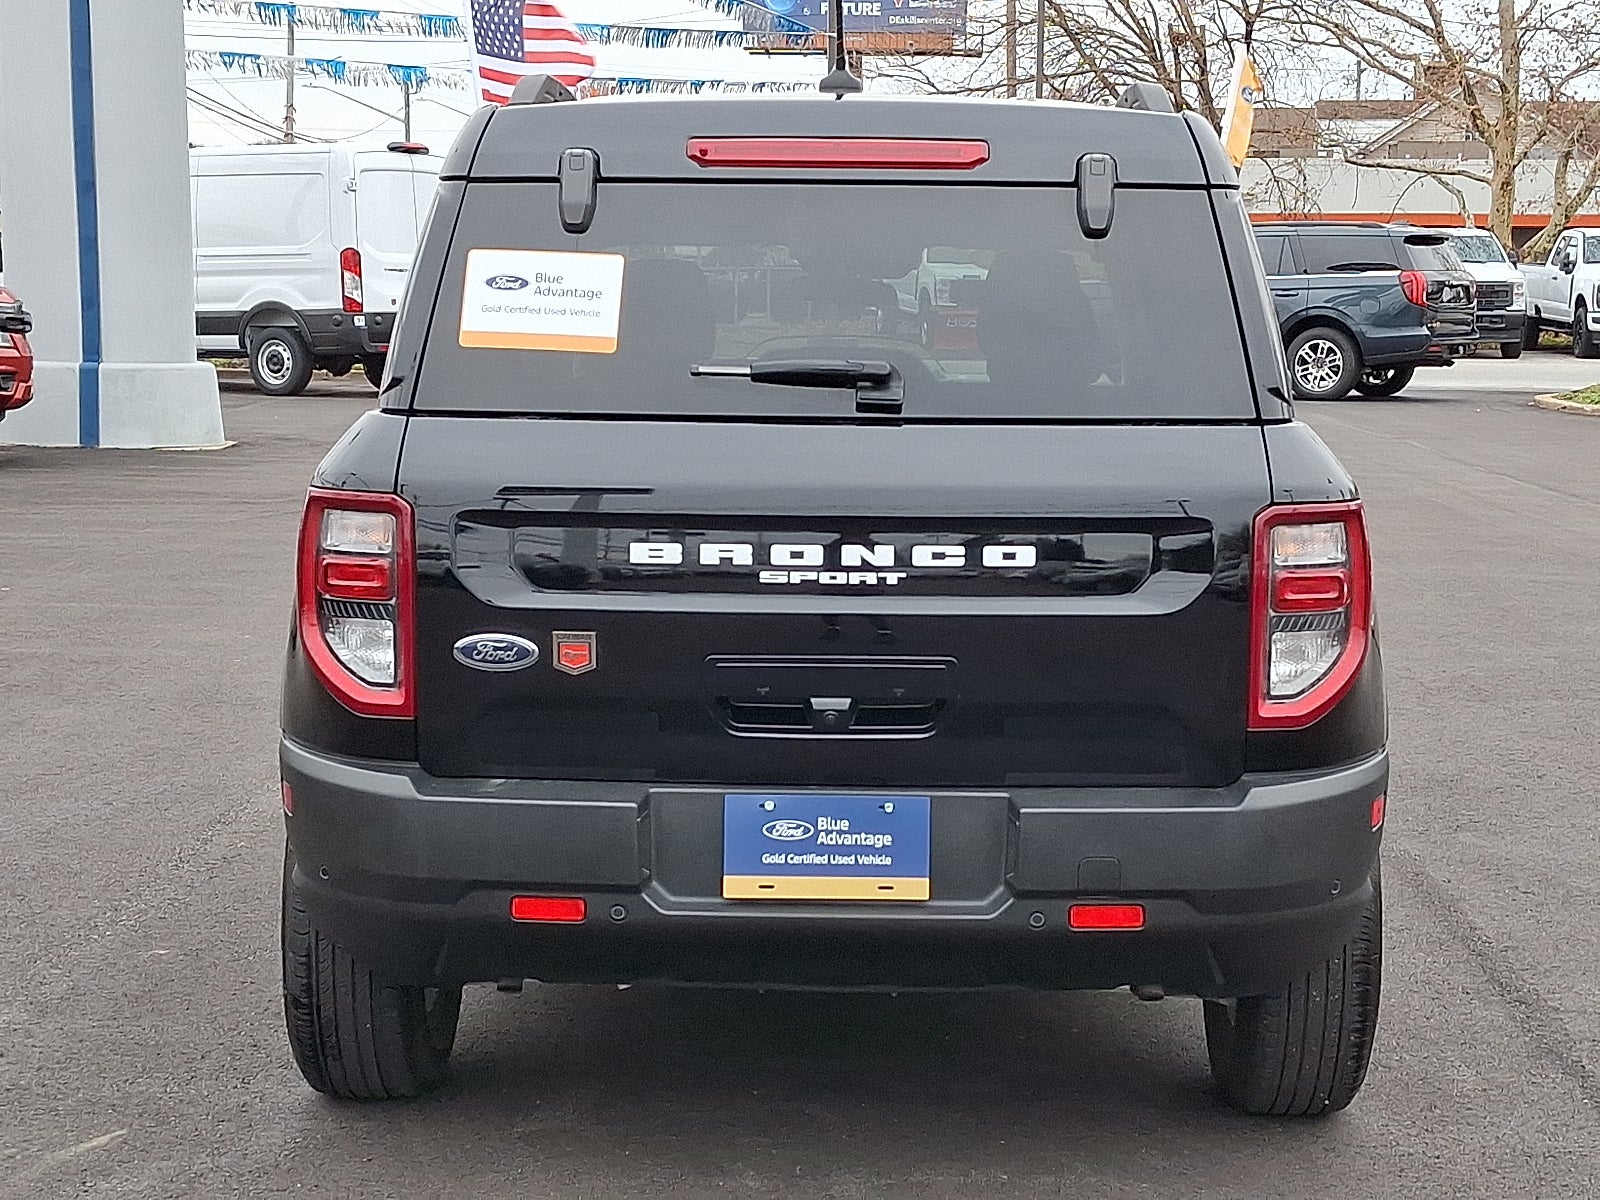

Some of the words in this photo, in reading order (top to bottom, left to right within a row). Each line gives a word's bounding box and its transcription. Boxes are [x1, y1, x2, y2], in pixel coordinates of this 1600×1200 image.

[820, 2, 882, 16] FTURE
[491, 276, 523, 290] Ford
[535, 273, 564, 285] Blue
[533, 286, 603, 301] Advantage
[481, 304, 502, 313] Gold
[504, 305, 541, 315] Certified
[544, 307, 567, 316] Used
[569, 308, 601, 318] Vehicle
[628, 542, 1037, 567] BRONCO
[758, 571, 908, 585] SPORT
[472, 640, 519, 662] Ford
[771, 822, 804, 838] Ford
[816, 816, 850, 831] Blue
[816, 831, 893, 848] Advantage
[761, 853, 786, 864] Gold
[787, 853, 829, 865] Certified
[829, 854, 856, 865] Used
[856, 854, 893, 865] Vehicle
